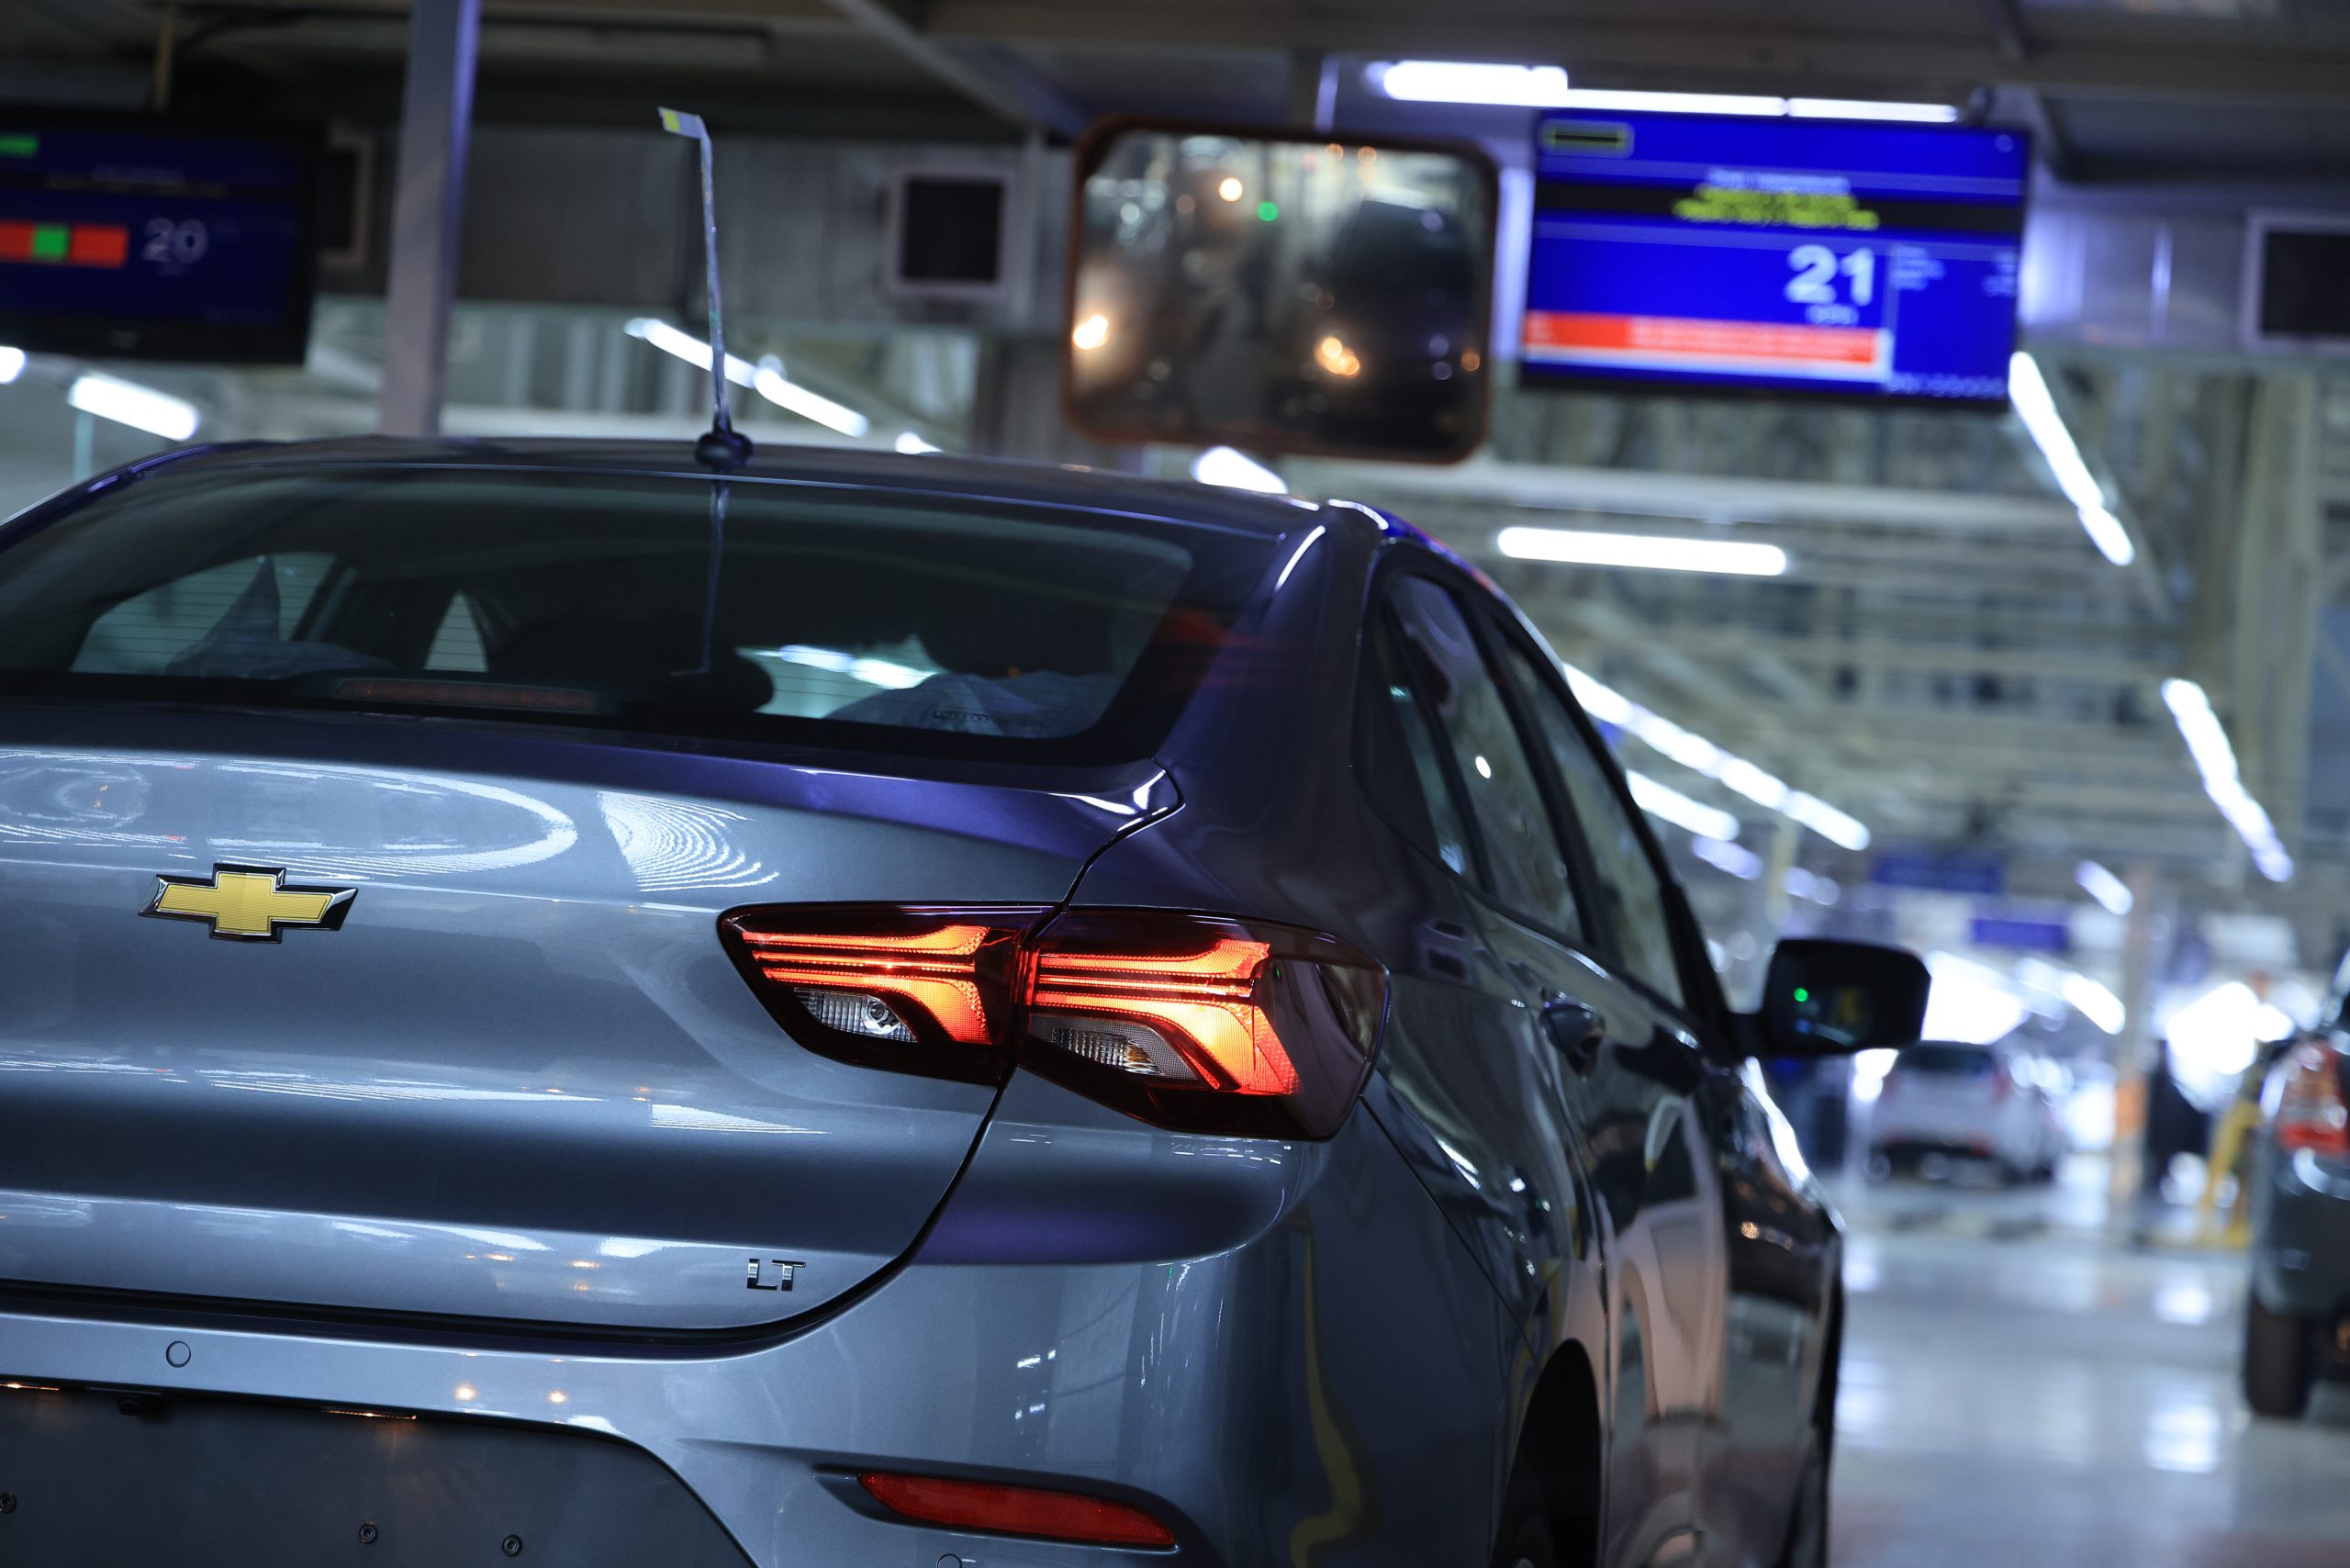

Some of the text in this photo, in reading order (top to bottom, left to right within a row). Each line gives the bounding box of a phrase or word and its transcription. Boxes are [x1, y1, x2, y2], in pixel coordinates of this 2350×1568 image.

[142, 218, 208, 263] 20
[1785, 244, 1874, 307] 21
[746, 1258, 806, 1292] LT
